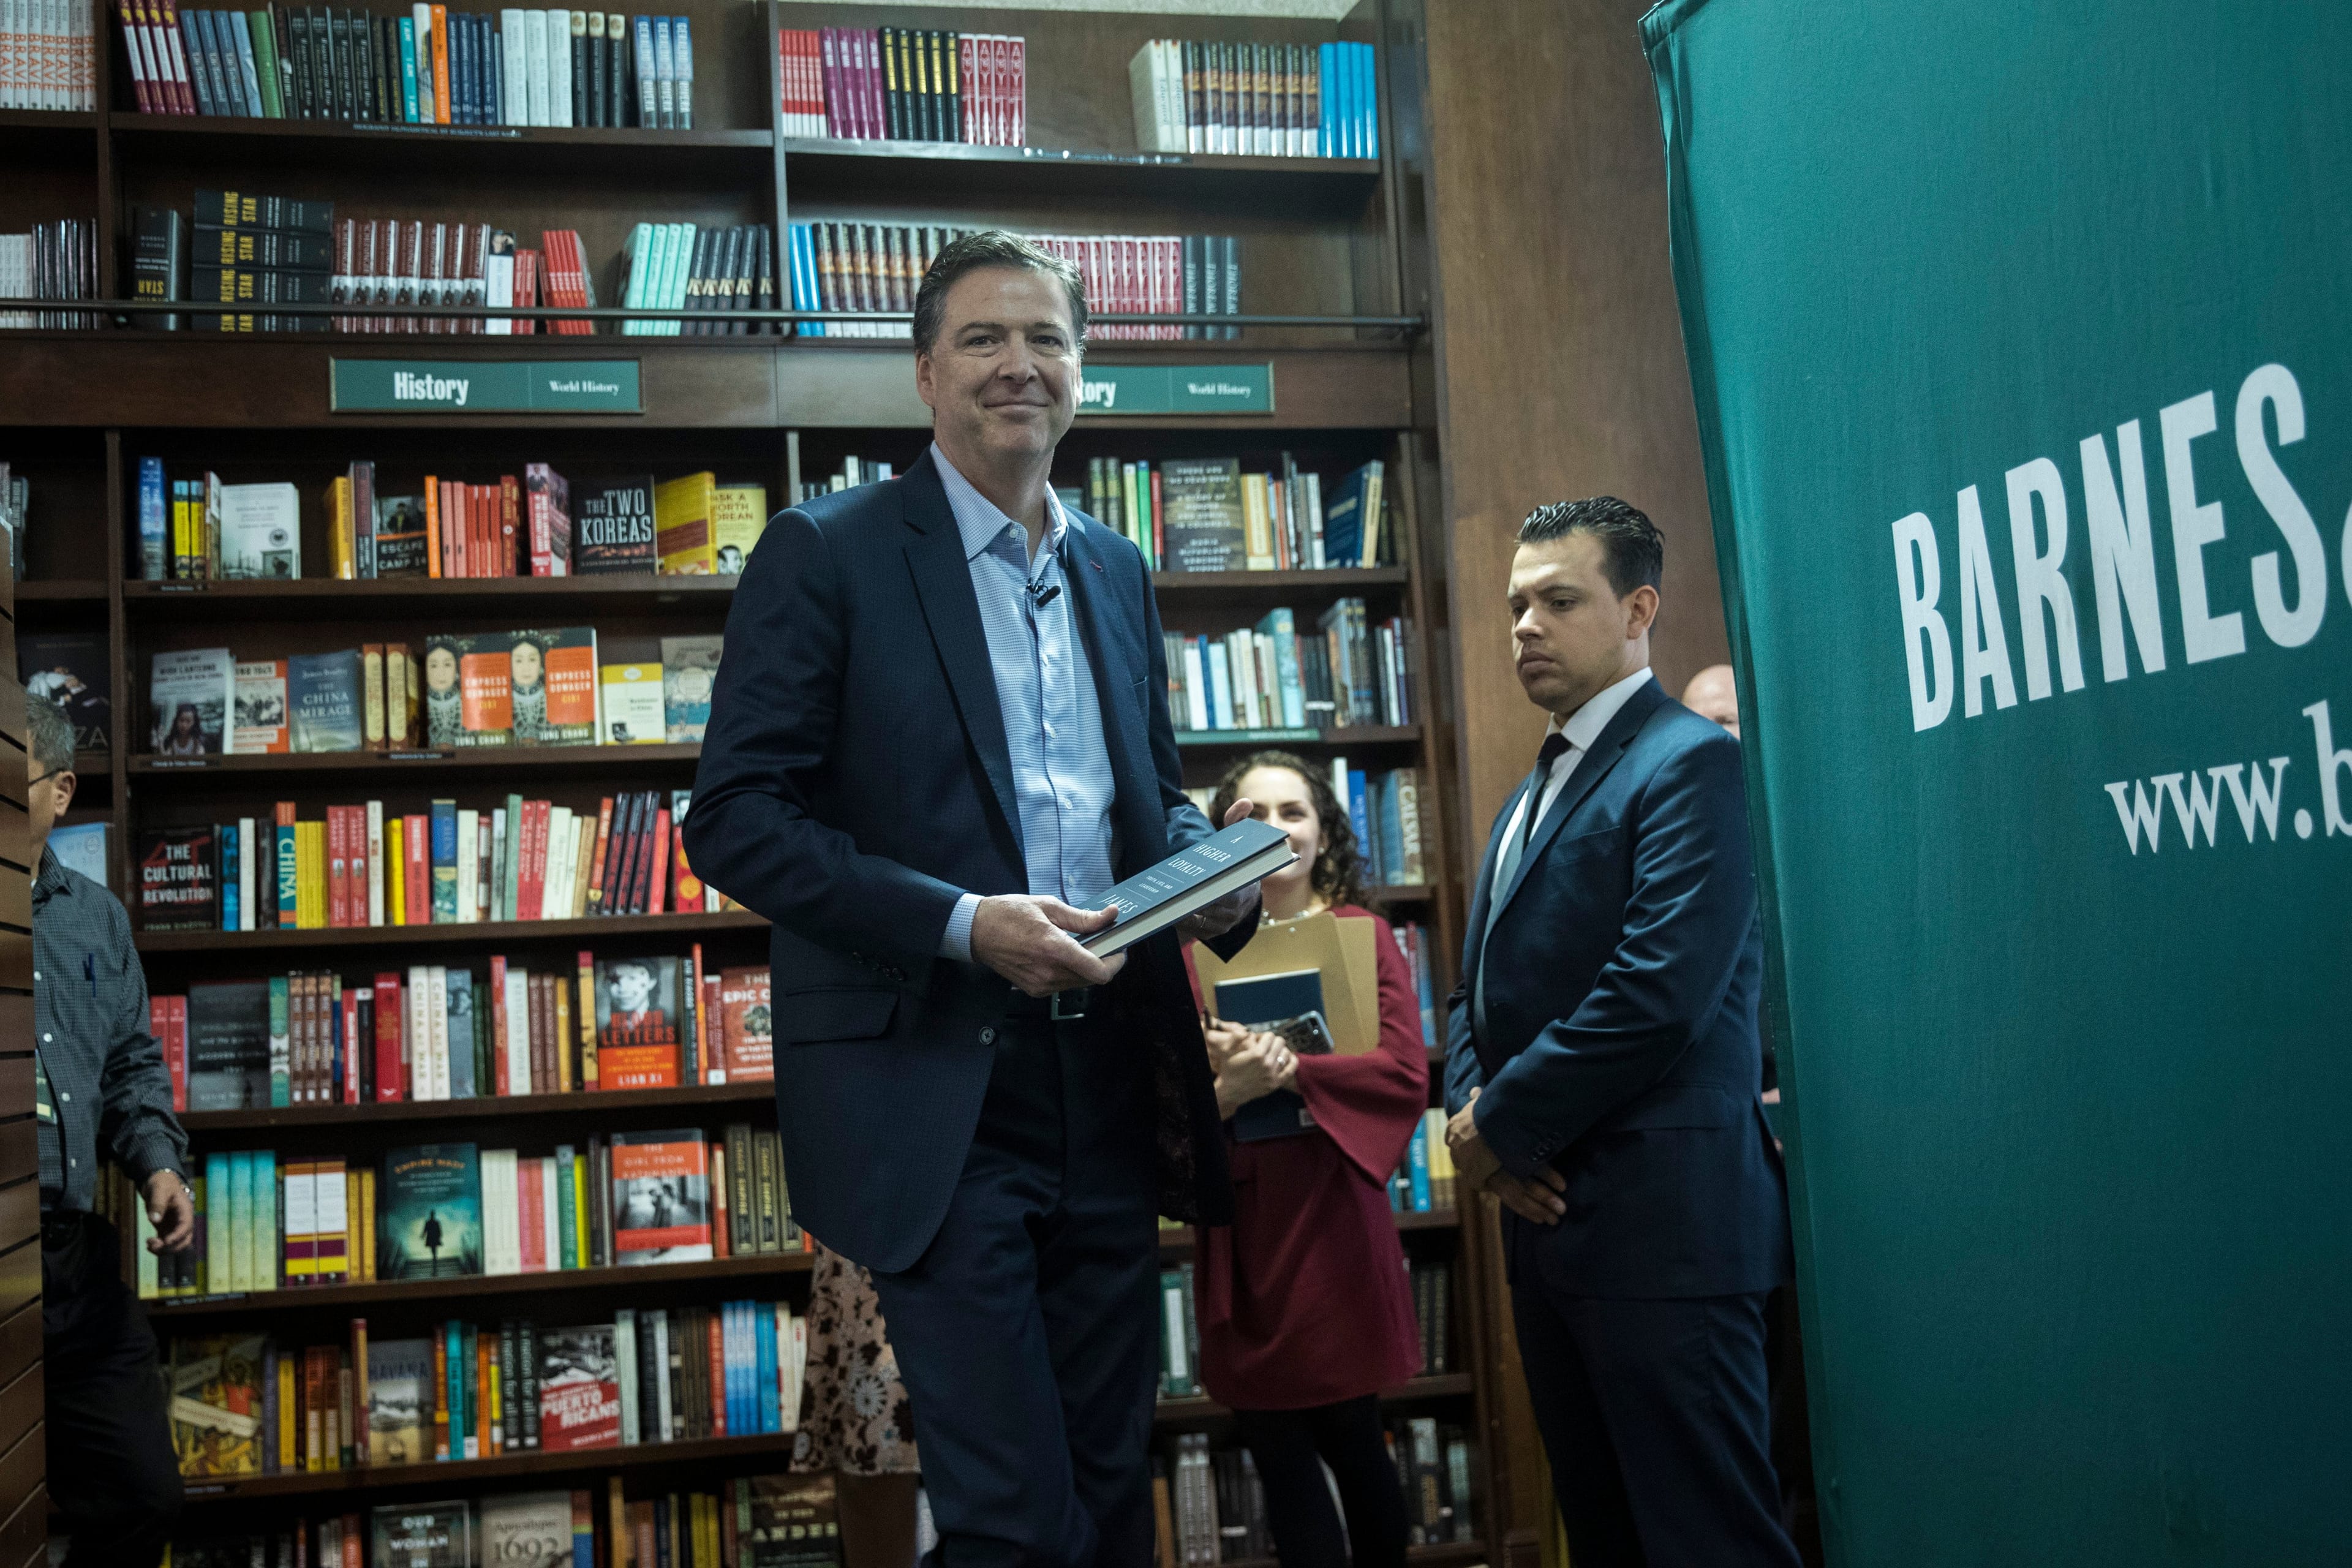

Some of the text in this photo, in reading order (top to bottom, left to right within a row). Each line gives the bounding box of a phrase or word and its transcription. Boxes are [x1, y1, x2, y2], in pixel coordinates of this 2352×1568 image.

[14, 34, 28, 90] BRAVE
[28, 34, 42, 91] BRAVE
[42, 35, 56, 91] BRAVE
[56, 36, 70, 92] BRAVE
[71, 37, 84, 93] BRAVE
[242, 197, 257, 222] STAR
[221, 231, 254, 265] RISING STAR
[137, 280, 164, 295] STAR
[220, 270, 254, 303] RISING STAR
[394, 371, 469, 406] History
[549, 380, 620, 396] World History
[1079, 377, 1117, 408] tory
[1187, 383, 1251, 398] World History
[585, 488, 646, 516] THE TWO
[715, 512, 754, 521] OREAN
[580, 515, 652, 546] KOREAS
[380, 541, 424, 554] ESCAPE
[1891, 362, 2326, 733] BARNES
[379, 558, 410, 570] CAMP
[464, 676, 508, 687] EMPRESS
[549, 670, 591, 682] EMPRESS
[465, 688, 508, 699] DOWAGER
[549, 681, 591, 693] DOWAGER
[303, 692, 349, 706] CHINA
[300, 705, 352, 719] MIRAGE
[454, 735, 506, 746] JUNG CHANG
[539, 728, 589, 741] JUNG CHANG
[1399, 785, 1422, 856] CAESAR
[1230, 835, 1244, 844] A
[165, 843, 191, 861] THE
[1193, 843, 1231, 863] HIGHER
[143, 863, 213, 883] CULTURAL
[278, 837, 296, 900] CHINA
[1167, 858, 1207, 876] LOYALTY
[143, 886, 213, 904] REVOLUTION
[1138, 883, 1159, 893] LEADERSHIP
[1097, 894, 1139, 914] JAMES
[744, 973, 771, 985] THE
[415, 981, 426, 1028] CHINA
[432, 982, 443, 1029] CHINA
[723, 990, 756, 1004] EPIC
[610, 1009, 663, 1028] BLOOD
[601, 1026, 676, 1047] LETTERS
[617, 1072, 663, 1085] LIAN XI
[394, 1158, 434, 1175] EMPIRE
[623, 1155, 685, 1167] GIRL FROM
[503, 1340, 516, 1378] nation
[520, 1339, 533, 1376] nation
[505, 1380, 518, 1398] for
[522, 1378, 535, 1398] for
[506, 1400, 519, 1414] all
[523, 1399, 537, 1414] all
[540, 1389, 603, 1419] PUERTO
[560, 1399, 620, 1429] RICANS
[401, 1514, 435, 1530] OUR
[752, 1521, 839, 1542] ANDES
[390, 1534, 448, 1550] WOMAN
[494, 1531, 558, 1561] 1692
